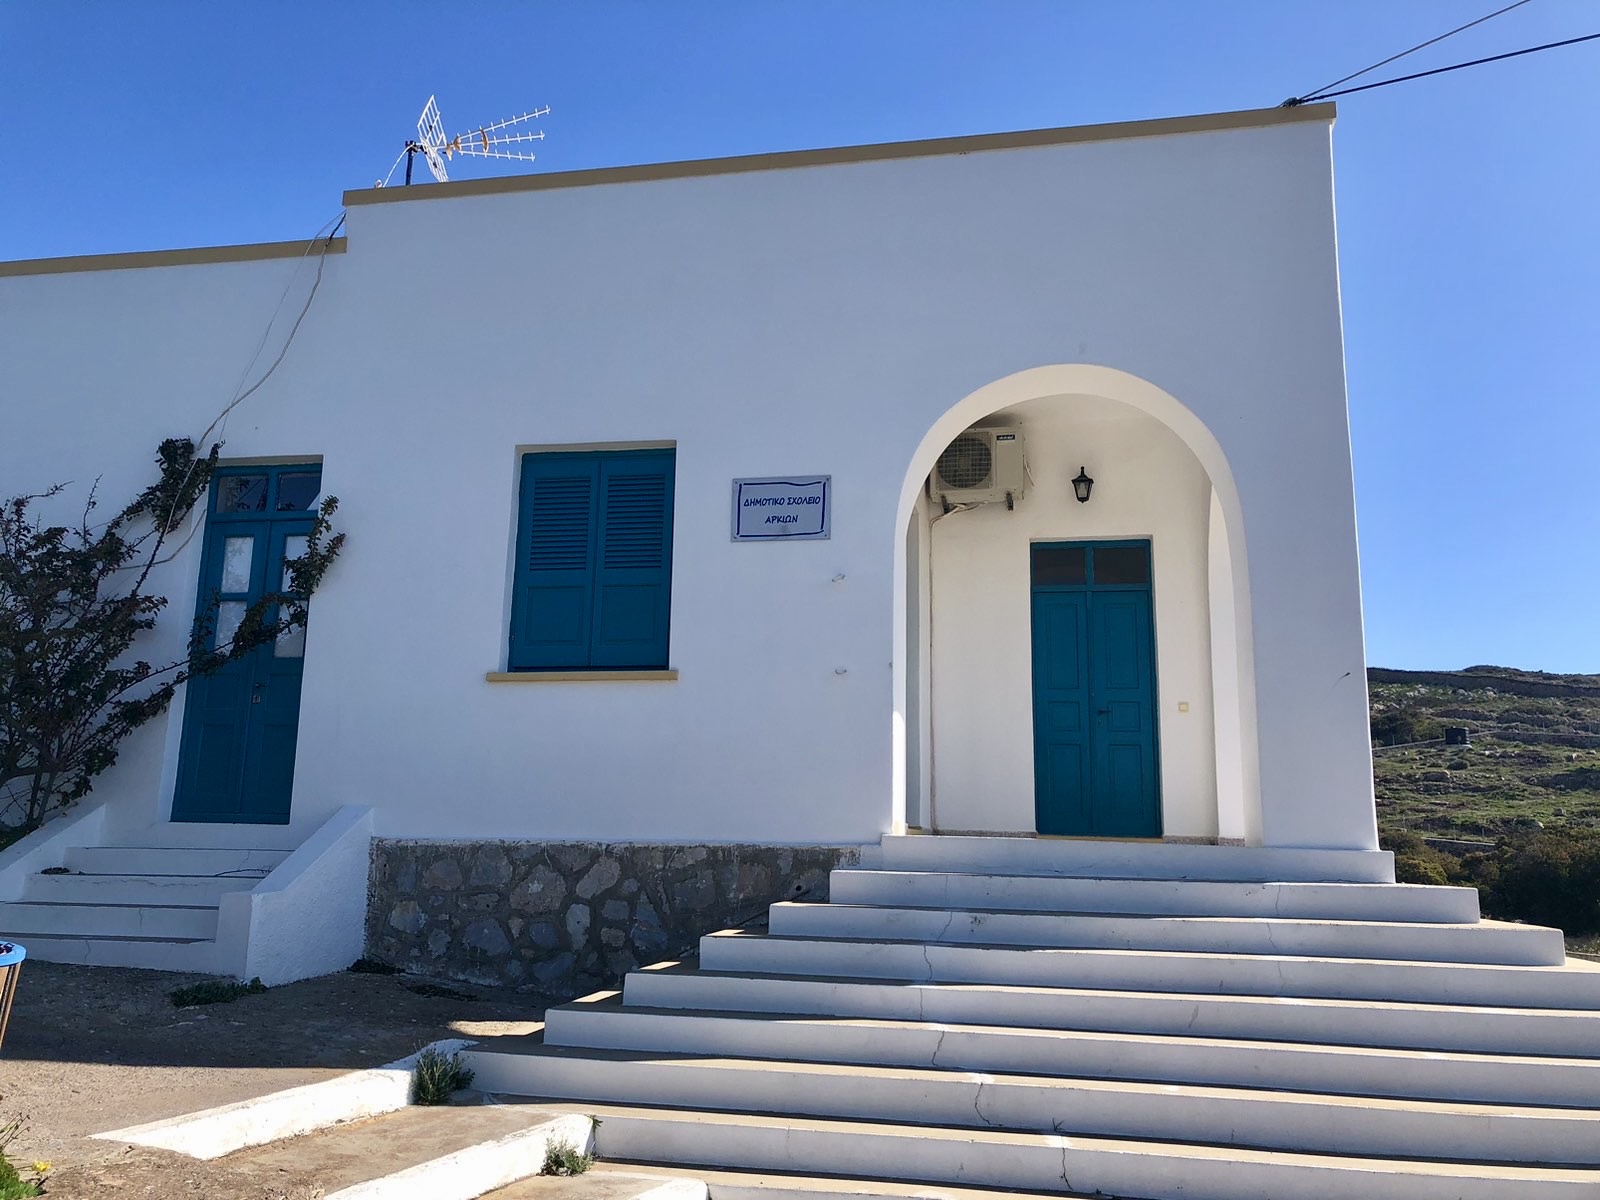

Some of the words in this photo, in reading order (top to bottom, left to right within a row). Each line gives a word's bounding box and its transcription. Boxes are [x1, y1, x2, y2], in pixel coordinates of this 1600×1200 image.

[743, 497, 785, 507] ΔΗΜΟΤΙΚΟ
[787, 496, 821, 506] ΣΧΟΛΕΙΟ
[765, 515, 799, 524] ΑΡΚΙΩΝ
